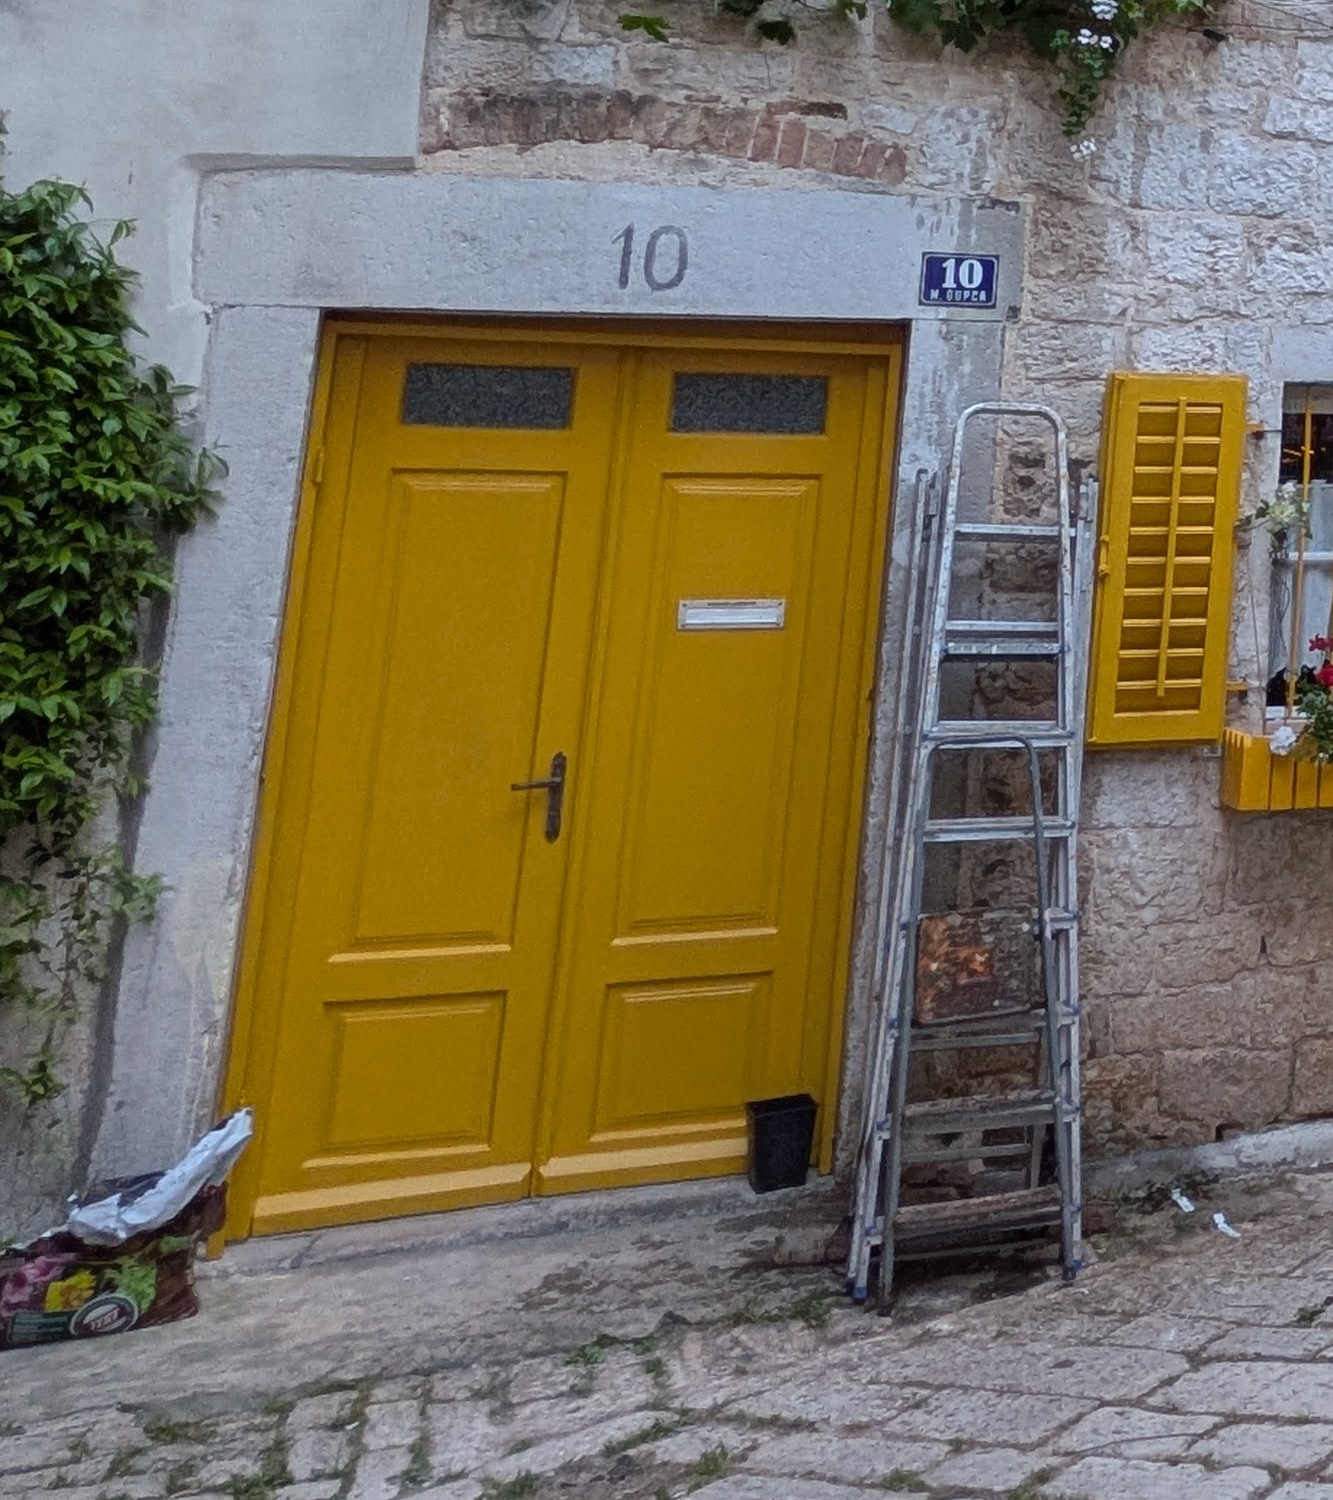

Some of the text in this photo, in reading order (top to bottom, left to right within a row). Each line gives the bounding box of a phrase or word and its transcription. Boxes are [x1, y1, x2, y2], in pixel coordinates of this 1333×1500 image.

[611, 221, 689, 293] 10
[941, 258, 984, 289] 10
[929, 288, 943, 301] M.
